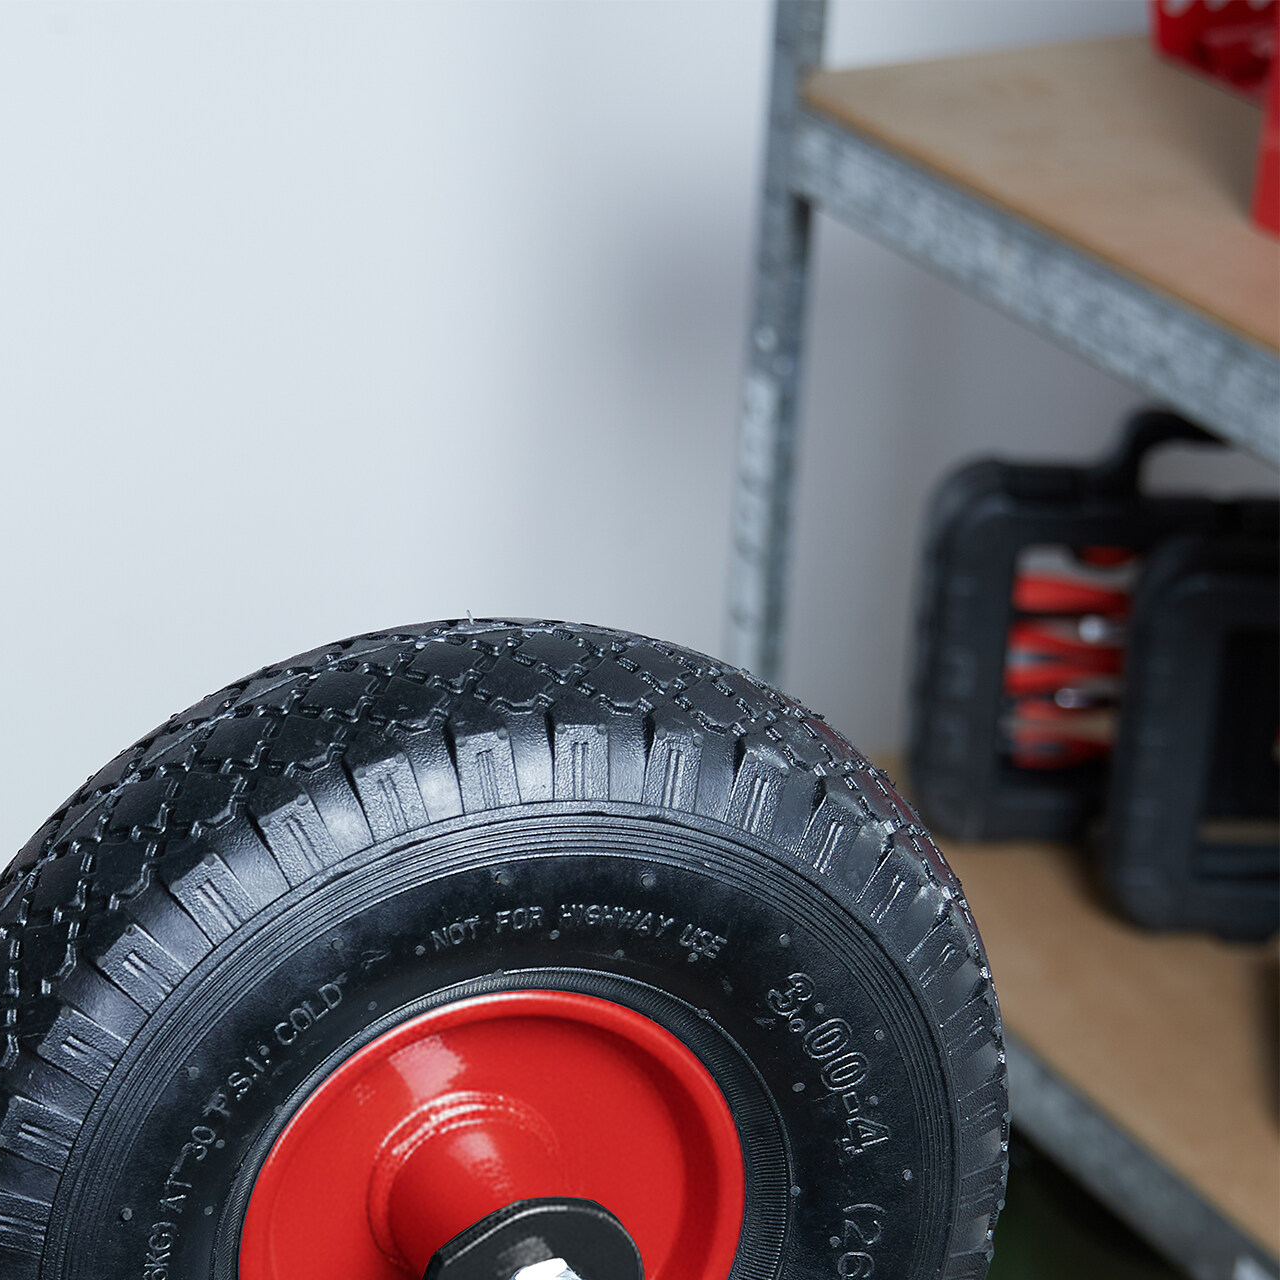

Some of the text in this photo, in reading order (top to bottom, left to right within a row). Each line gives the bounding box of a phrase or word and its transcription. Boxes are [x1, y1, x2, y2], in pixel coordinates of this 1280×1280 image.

[431, 904, 728, 959] NOT FOR HIGHWAY USE
[159, 1174, 193, 1214] AT
[180, 1125, 216, 1161] 30
[274, 983, 343, 1046] COLD
[767, 972, 891, 1156] 3.00-4
